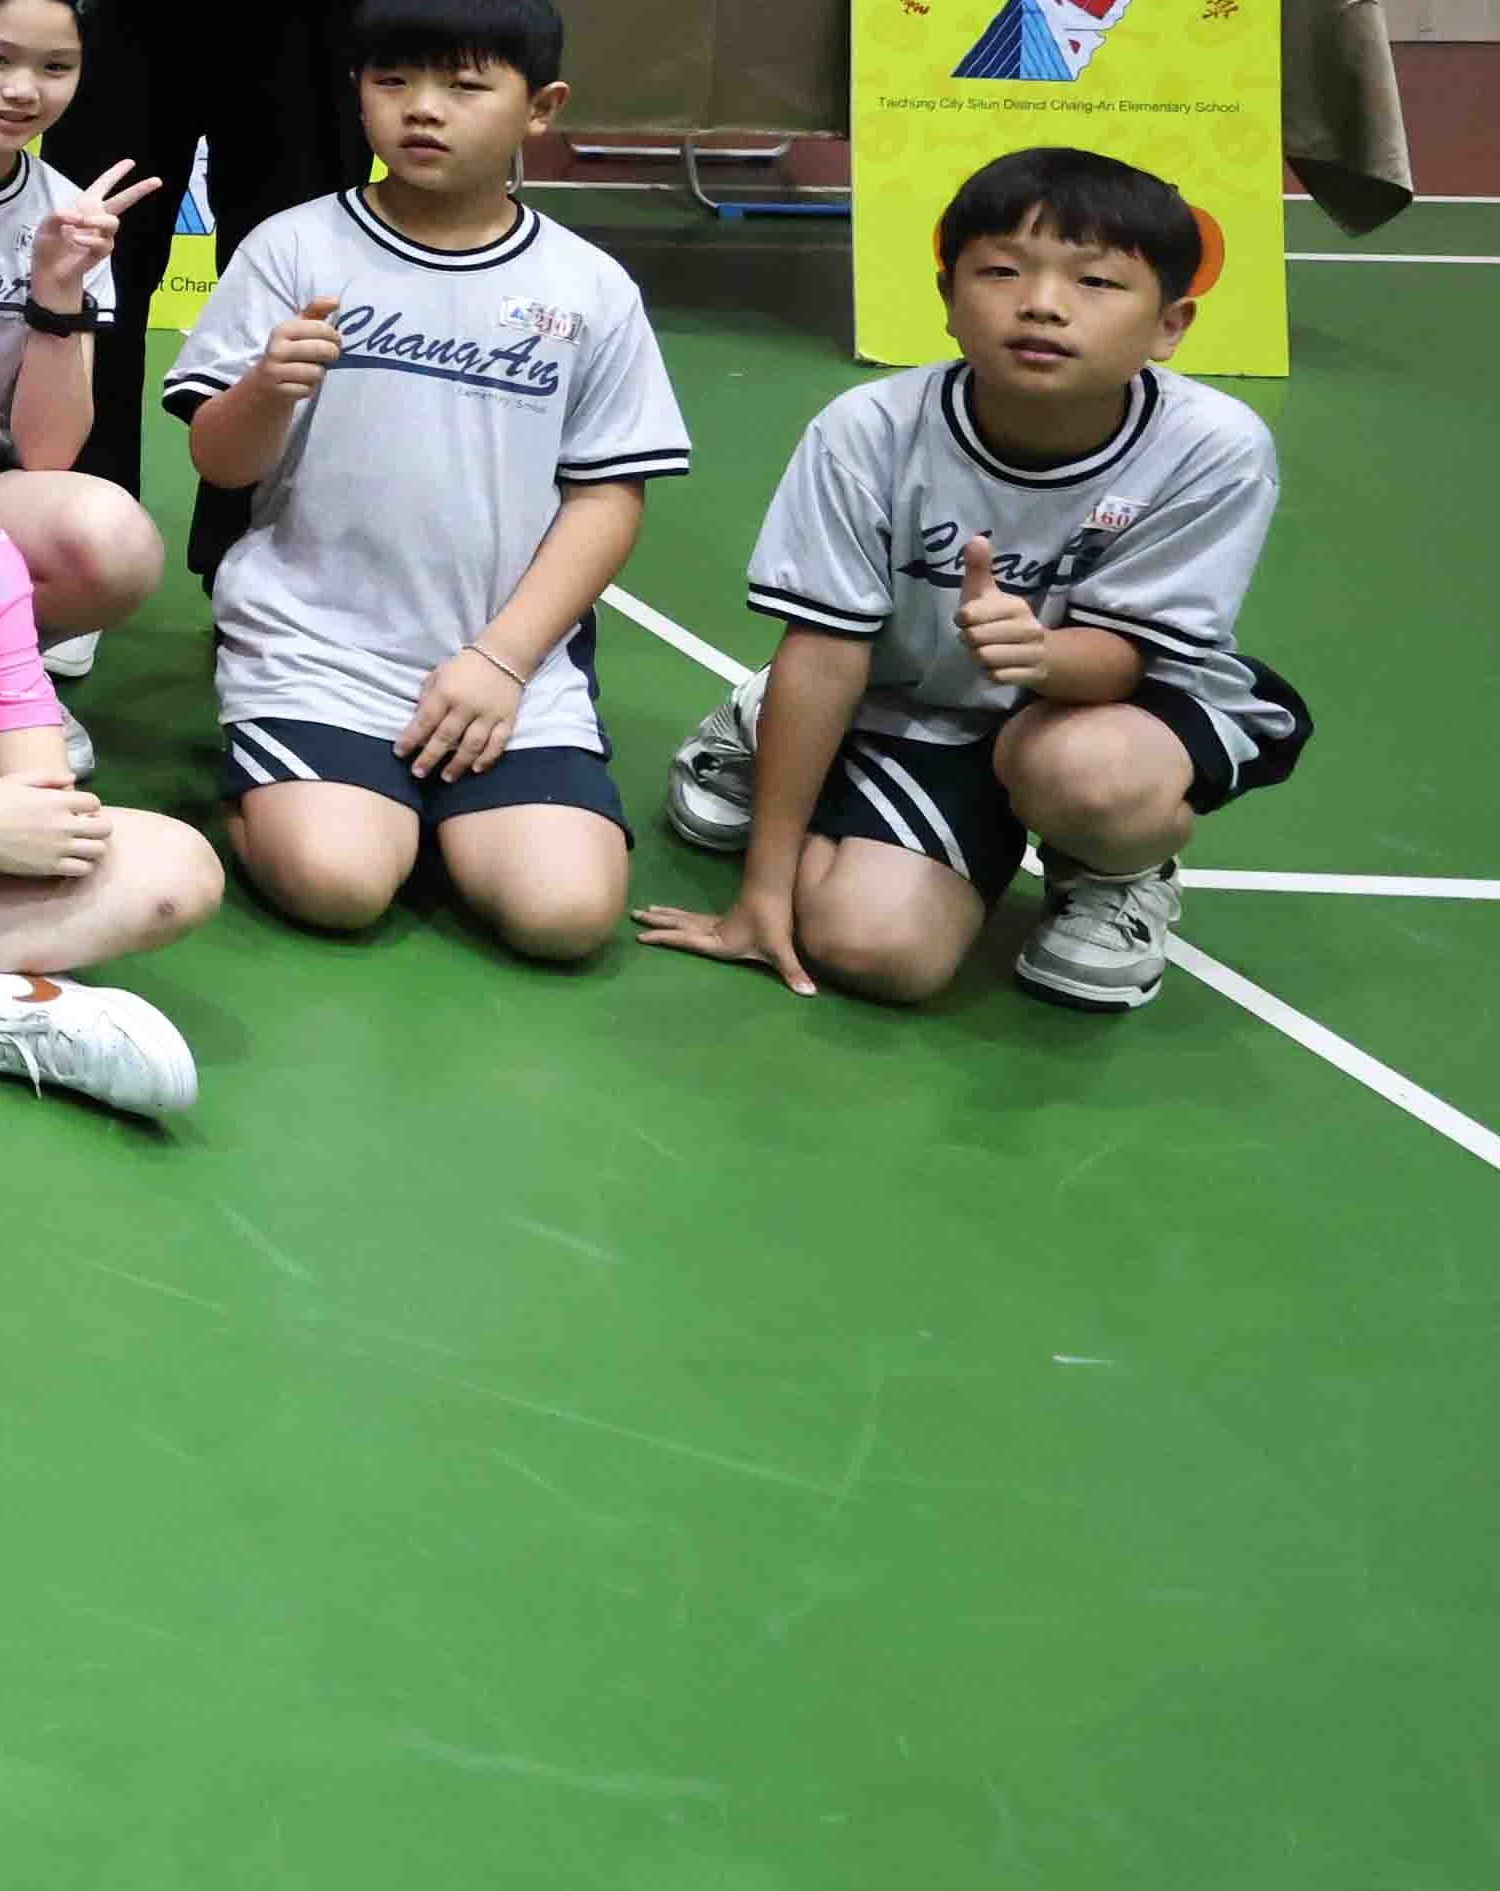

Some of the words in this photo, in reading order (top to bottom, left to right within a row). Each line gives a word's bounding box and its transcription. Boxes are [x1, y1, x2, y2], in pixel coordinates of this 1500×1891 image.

[939, 96, 964, 111] City
[1195, 101, 1241, 114] School
[335, 305, 559, 388] ChangAn
